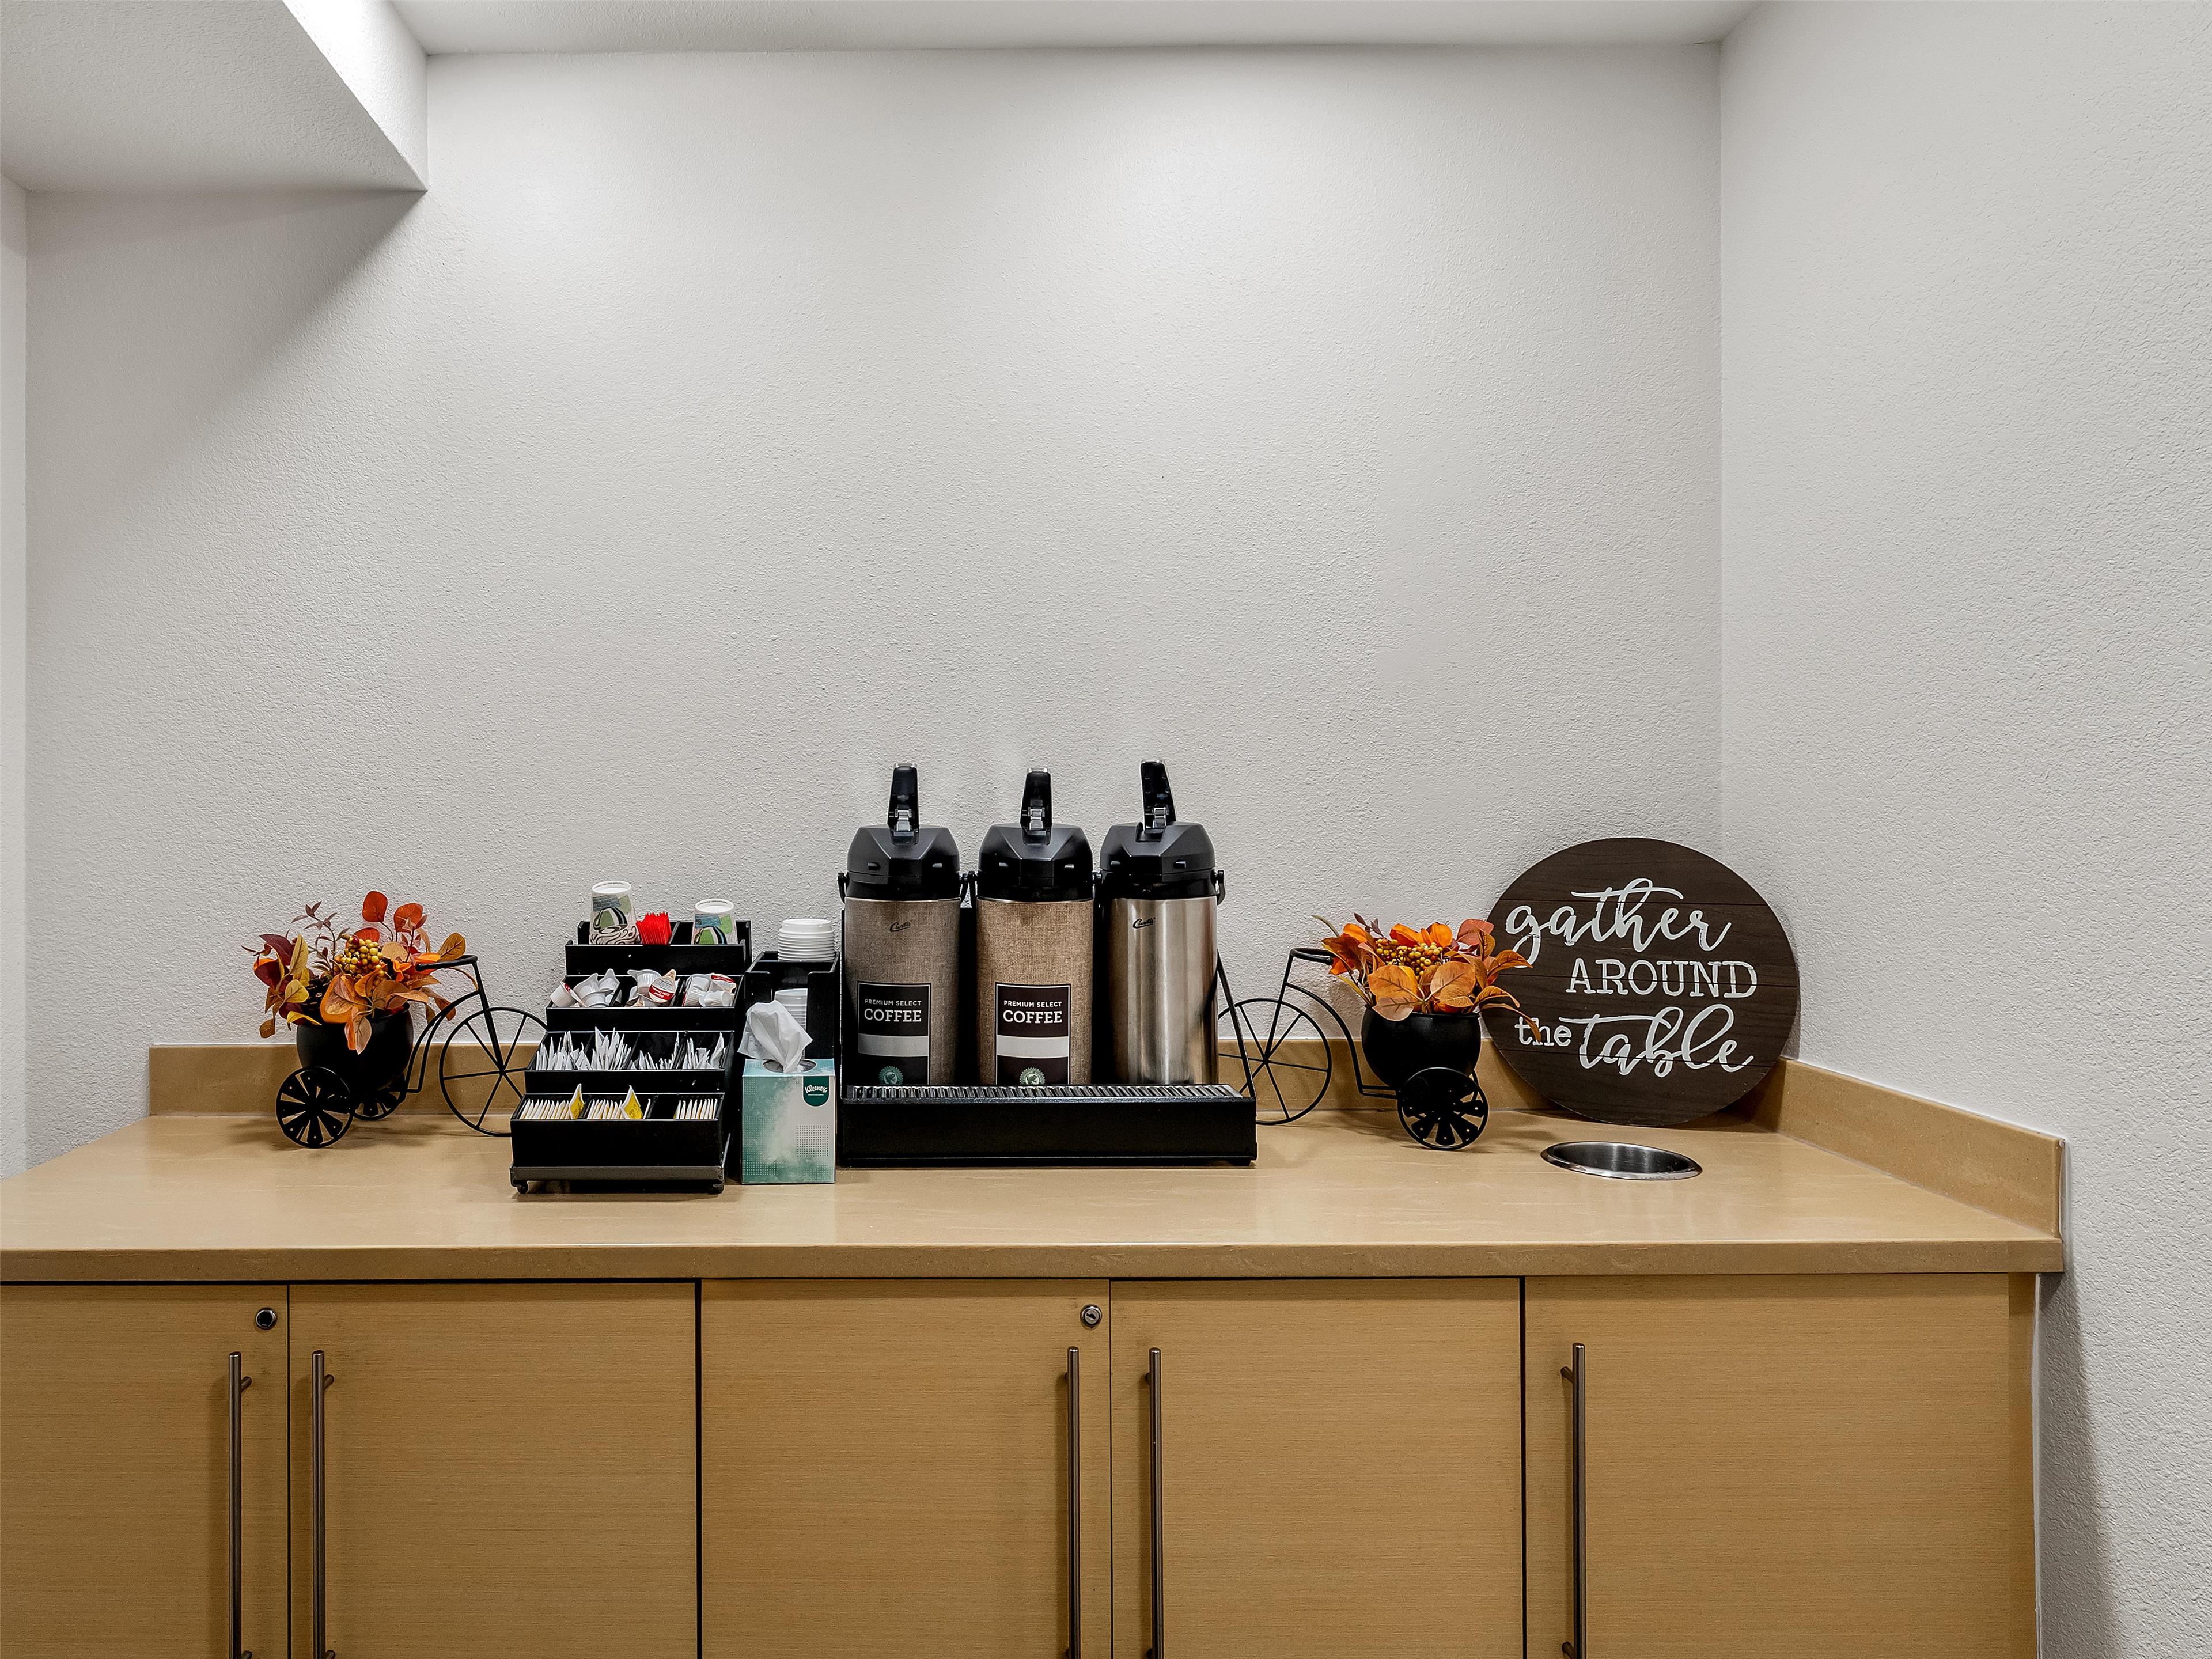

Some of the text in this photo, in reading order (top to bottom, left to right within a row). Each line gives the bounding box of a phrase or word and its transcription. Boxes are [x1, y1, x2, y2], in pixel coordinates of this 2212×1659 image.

[1506, 878, 1732, 968] gather
[1566, 958, 1758, 998] AROUND
[865, 1008, 922, 1022] COFFEE
[1003, 1010, 1062, 1024] COFFEE
[1514, 1004, 1754, 1078] the table
[805, 1084, 828, 1093] Kleenex
